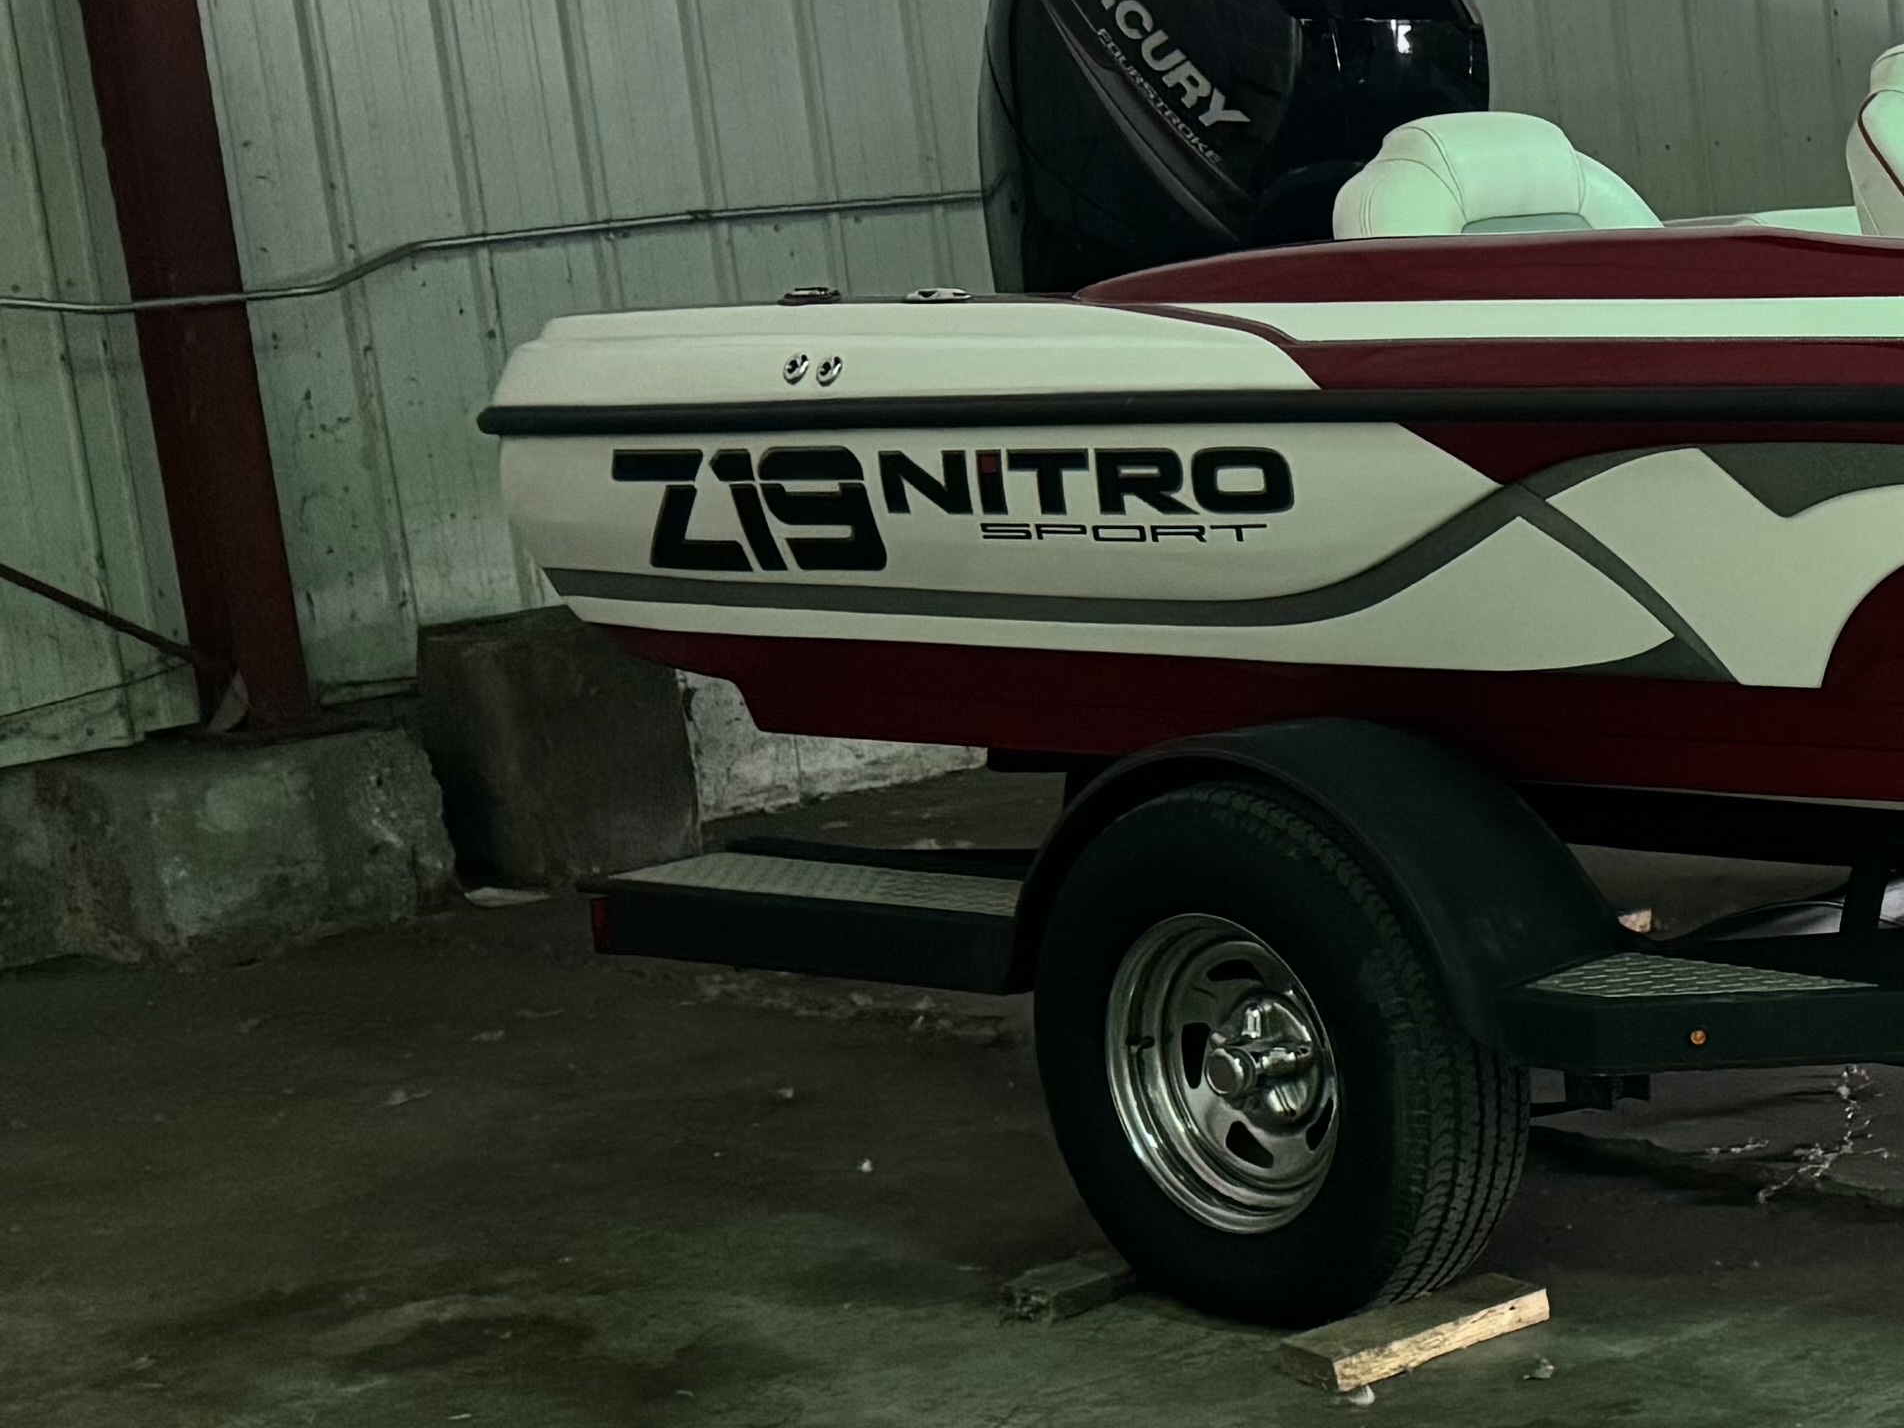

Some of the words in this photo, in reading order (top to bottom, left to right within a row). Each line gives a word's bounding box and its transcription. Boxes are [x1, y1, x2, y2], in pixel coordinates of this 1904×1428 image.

[611, 445, 888, 572] Z19
[878, 446, 1296, 516] NITRO
[979, 522, 1268, 544] SPORT
